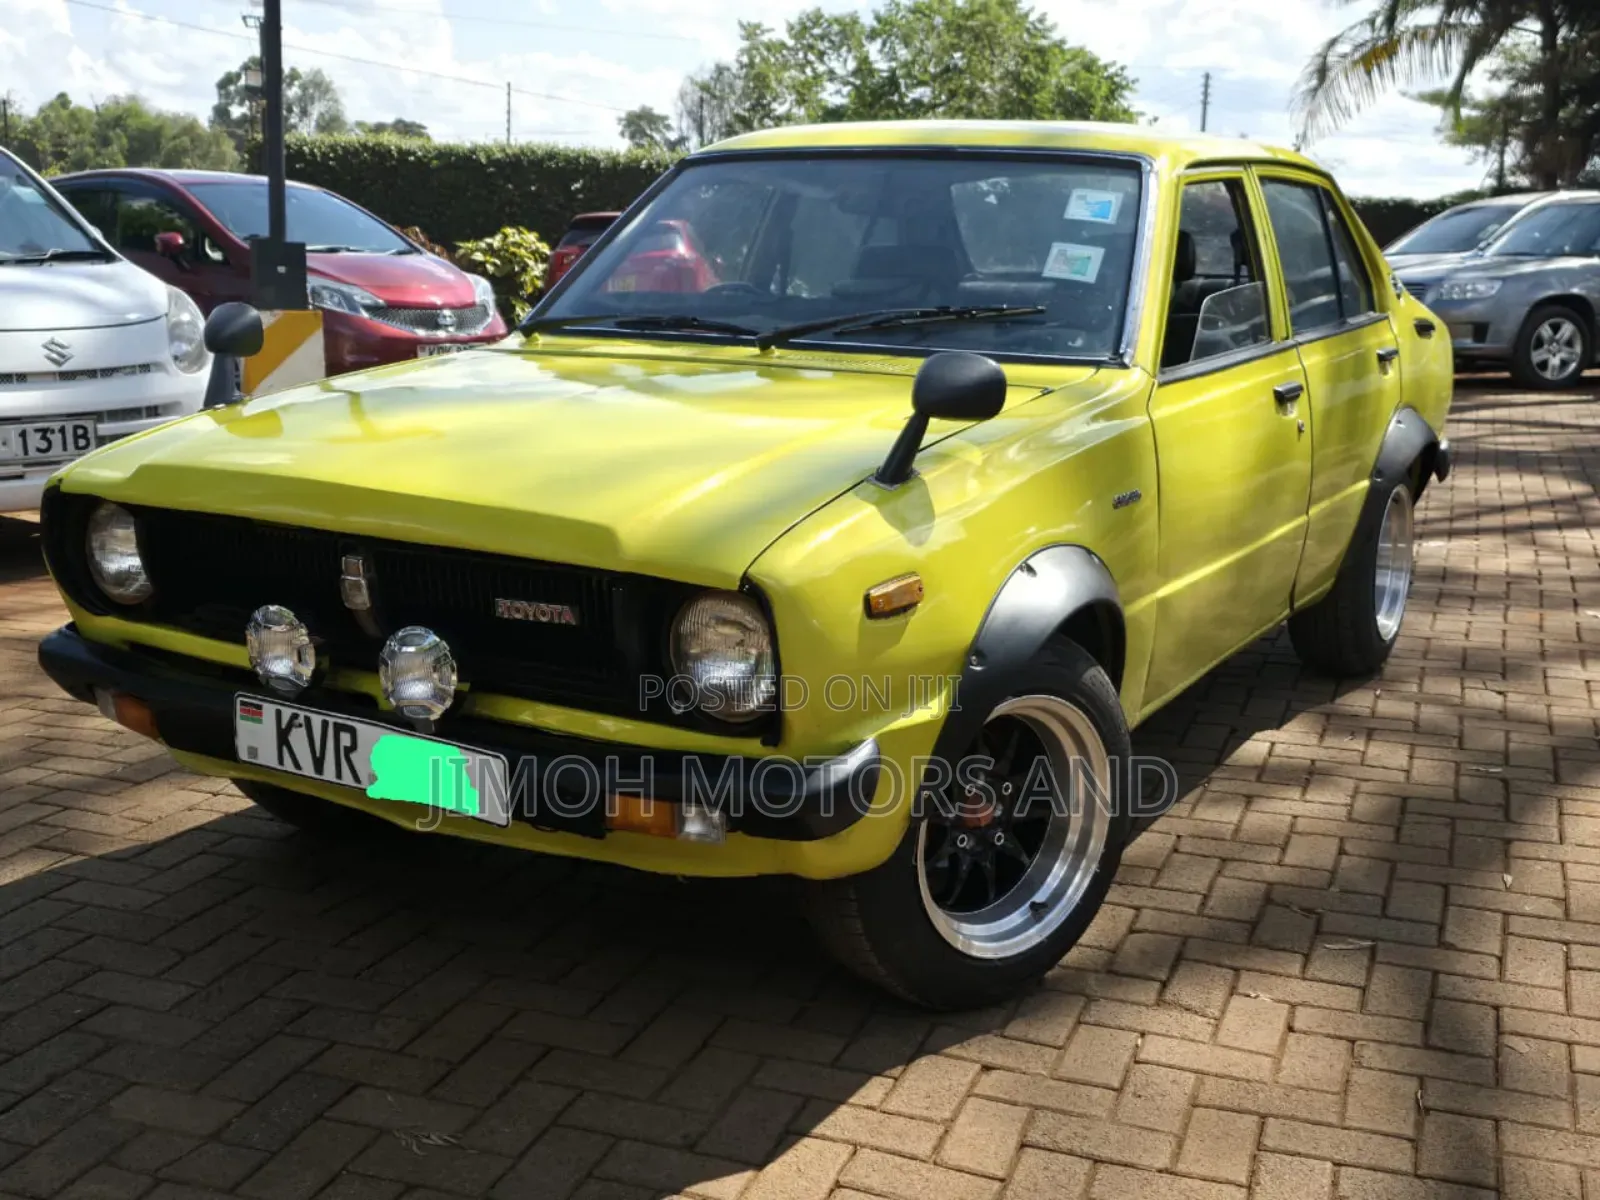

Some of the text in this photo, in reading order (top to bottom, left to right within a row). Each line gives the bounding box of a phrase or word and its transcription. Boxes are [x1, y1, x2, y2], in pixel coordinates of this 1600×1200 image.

[19, 424, 91, 456] 131B
[496, 599, 577, 625] TOYOTA
[276, 708, 362, 785] KVR
